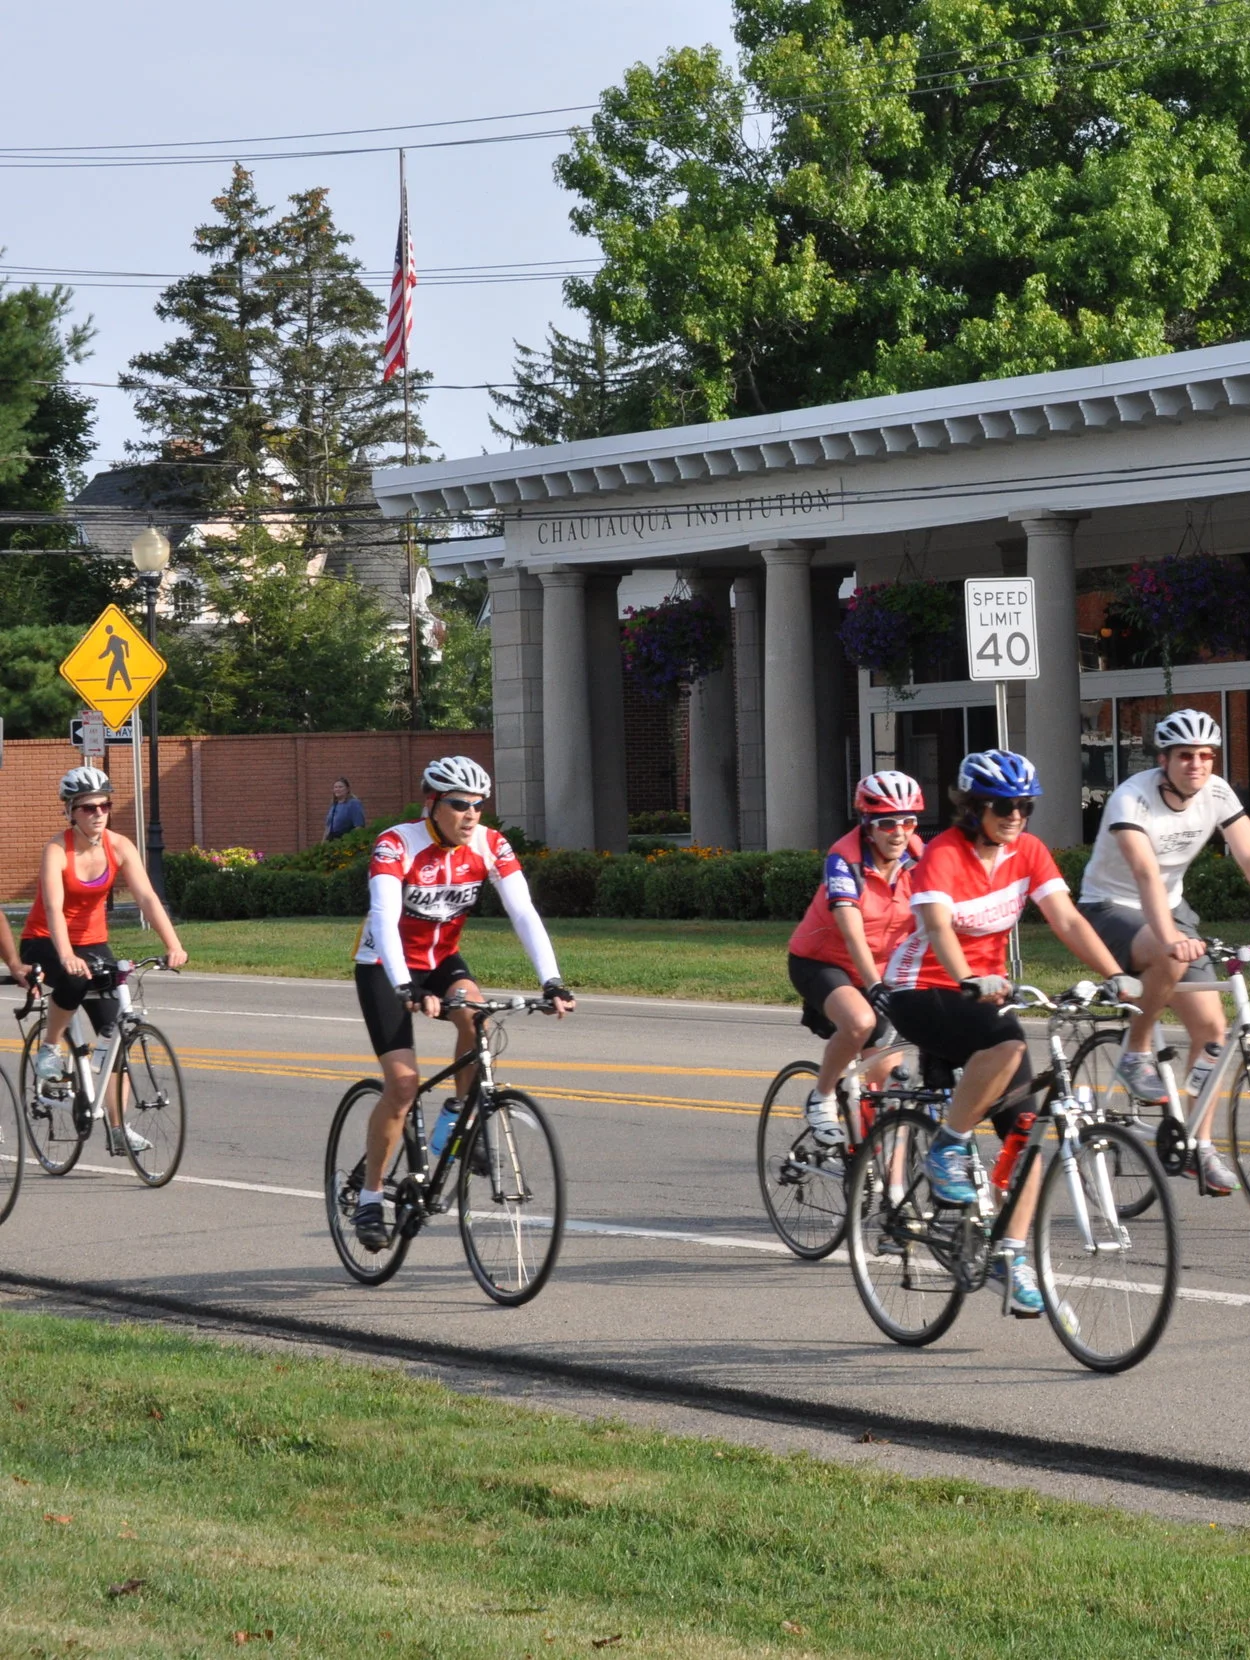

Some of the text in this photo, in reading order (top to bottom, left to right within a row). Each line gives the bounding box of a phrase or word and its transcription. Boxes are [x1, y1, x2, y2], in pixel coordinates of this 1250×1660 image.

[538, 487, 830, 545] CHAUTAUQUA INSTITUTION
[973, 591, 1028, 606] SPEED
[979, 611, 1022, 627] LIMIT
[976, 631, 1030, 667] 40
